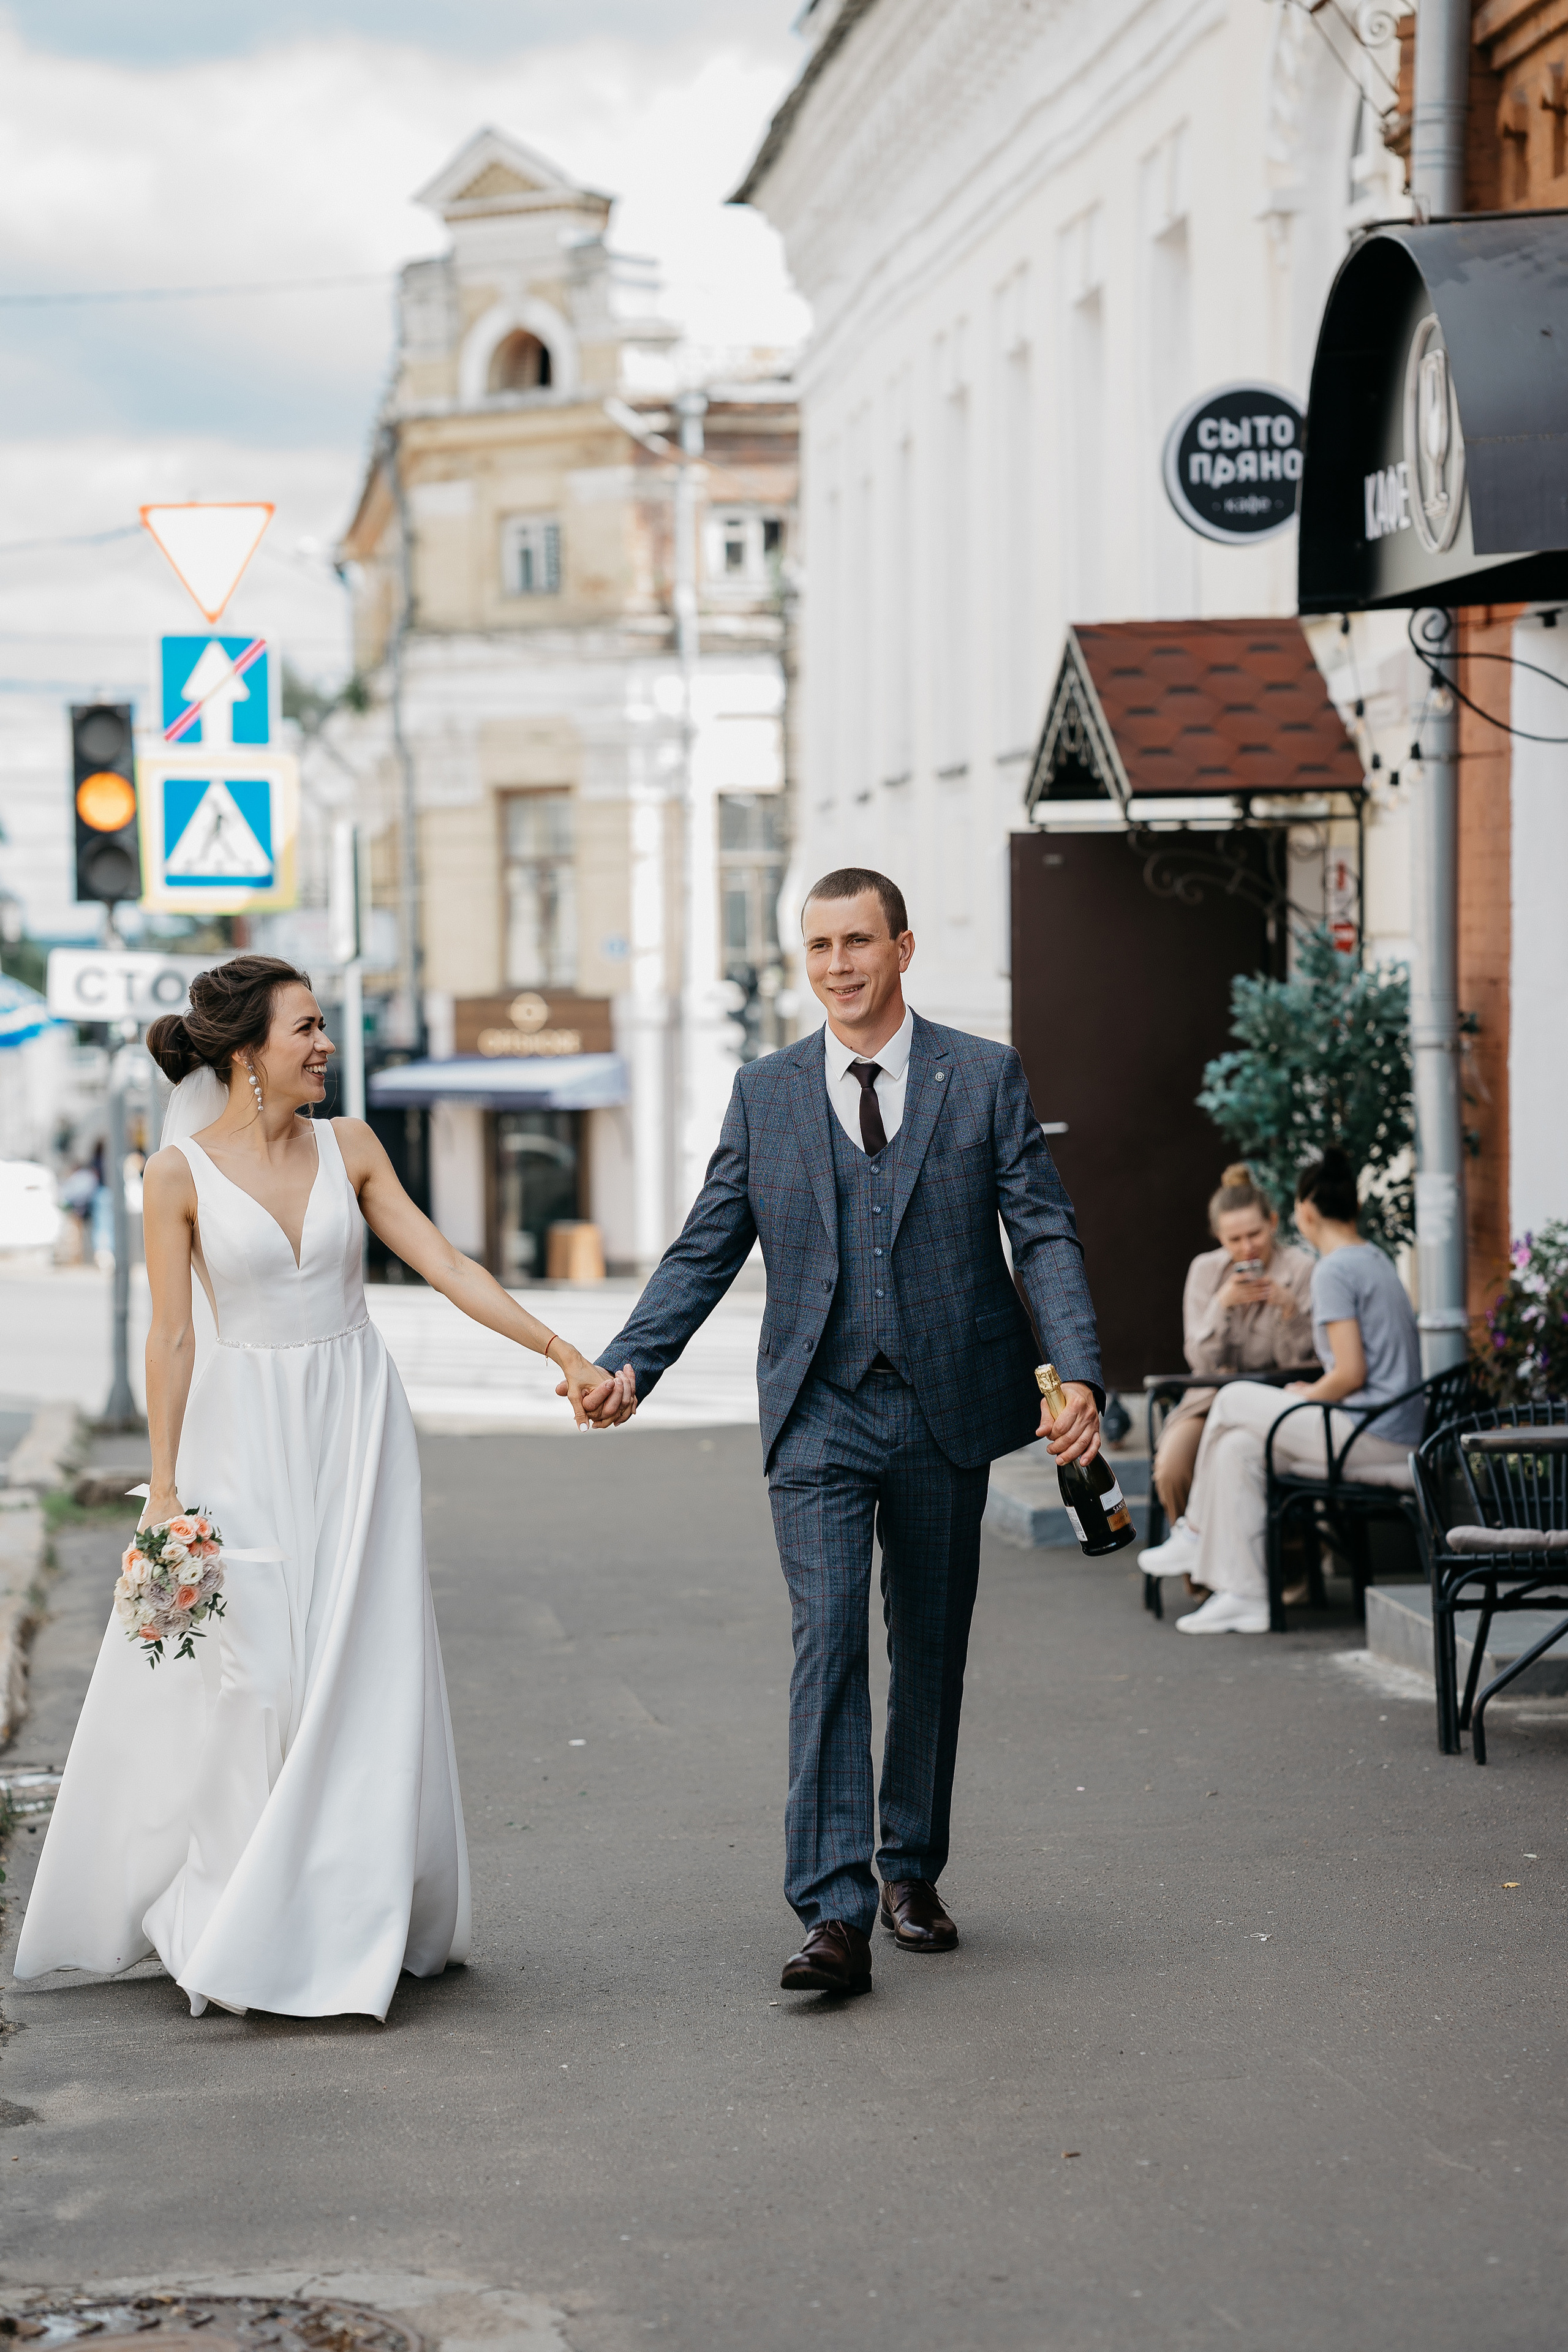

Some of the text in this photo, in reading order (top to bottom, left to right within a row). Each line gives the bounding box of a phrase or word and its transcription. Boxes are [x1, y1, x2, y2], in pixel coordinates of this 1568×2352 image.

[1197, 414, 1295, 451] СЫТО
[1364, 462, 1411, 541] КАФЕ
[74, 966, 186, 1006] СТО
